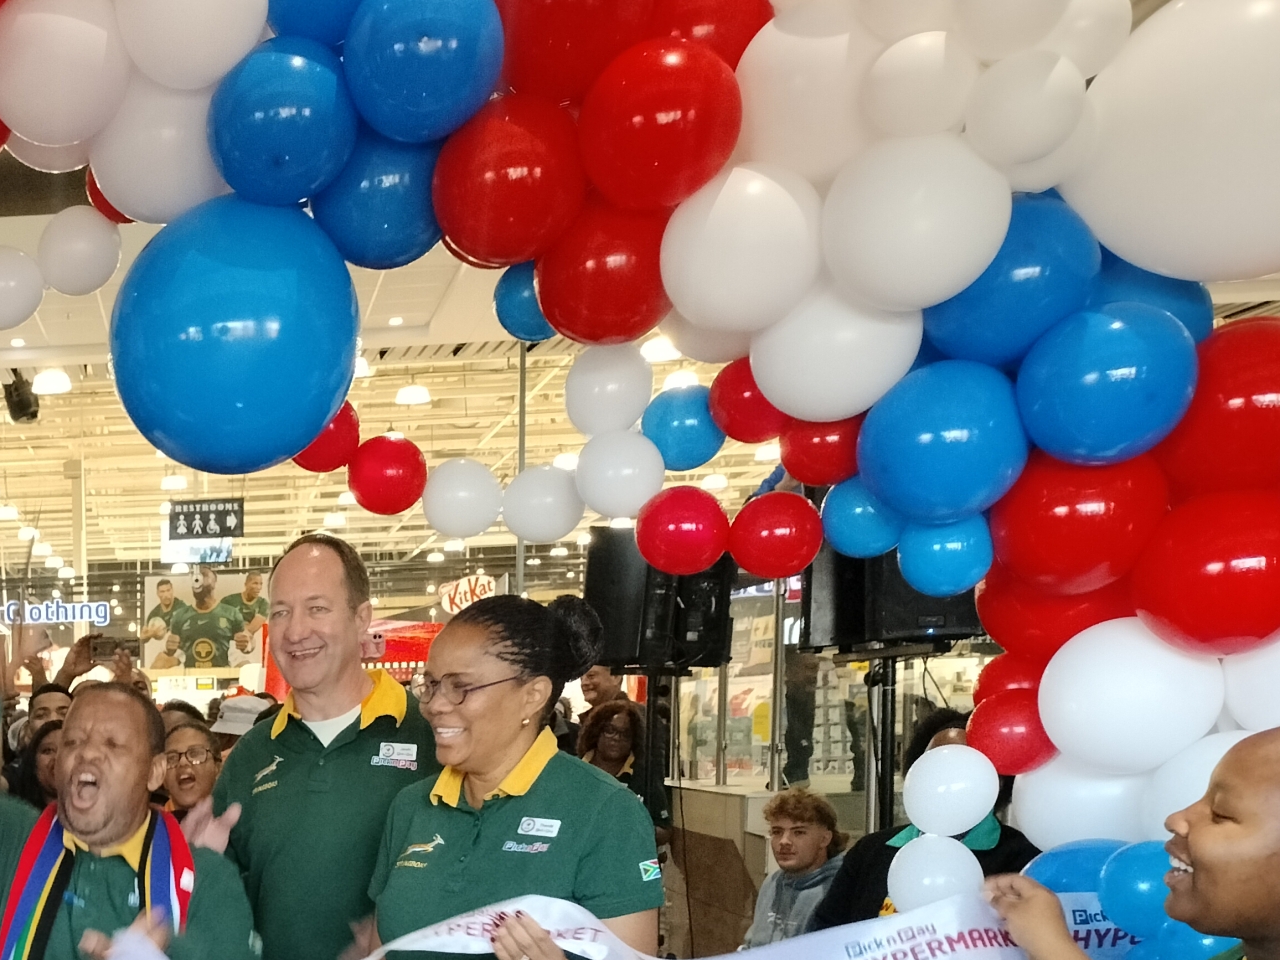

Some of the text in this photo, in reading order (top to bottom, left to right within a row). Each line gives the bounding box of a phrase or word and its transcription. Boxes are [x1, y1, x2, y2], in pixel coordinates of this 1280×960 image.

[175, 503, 239, 513] RESTROOMS
[448, 577, 493, 612] KitKat
[5, 600, 110, 626] Clothing
